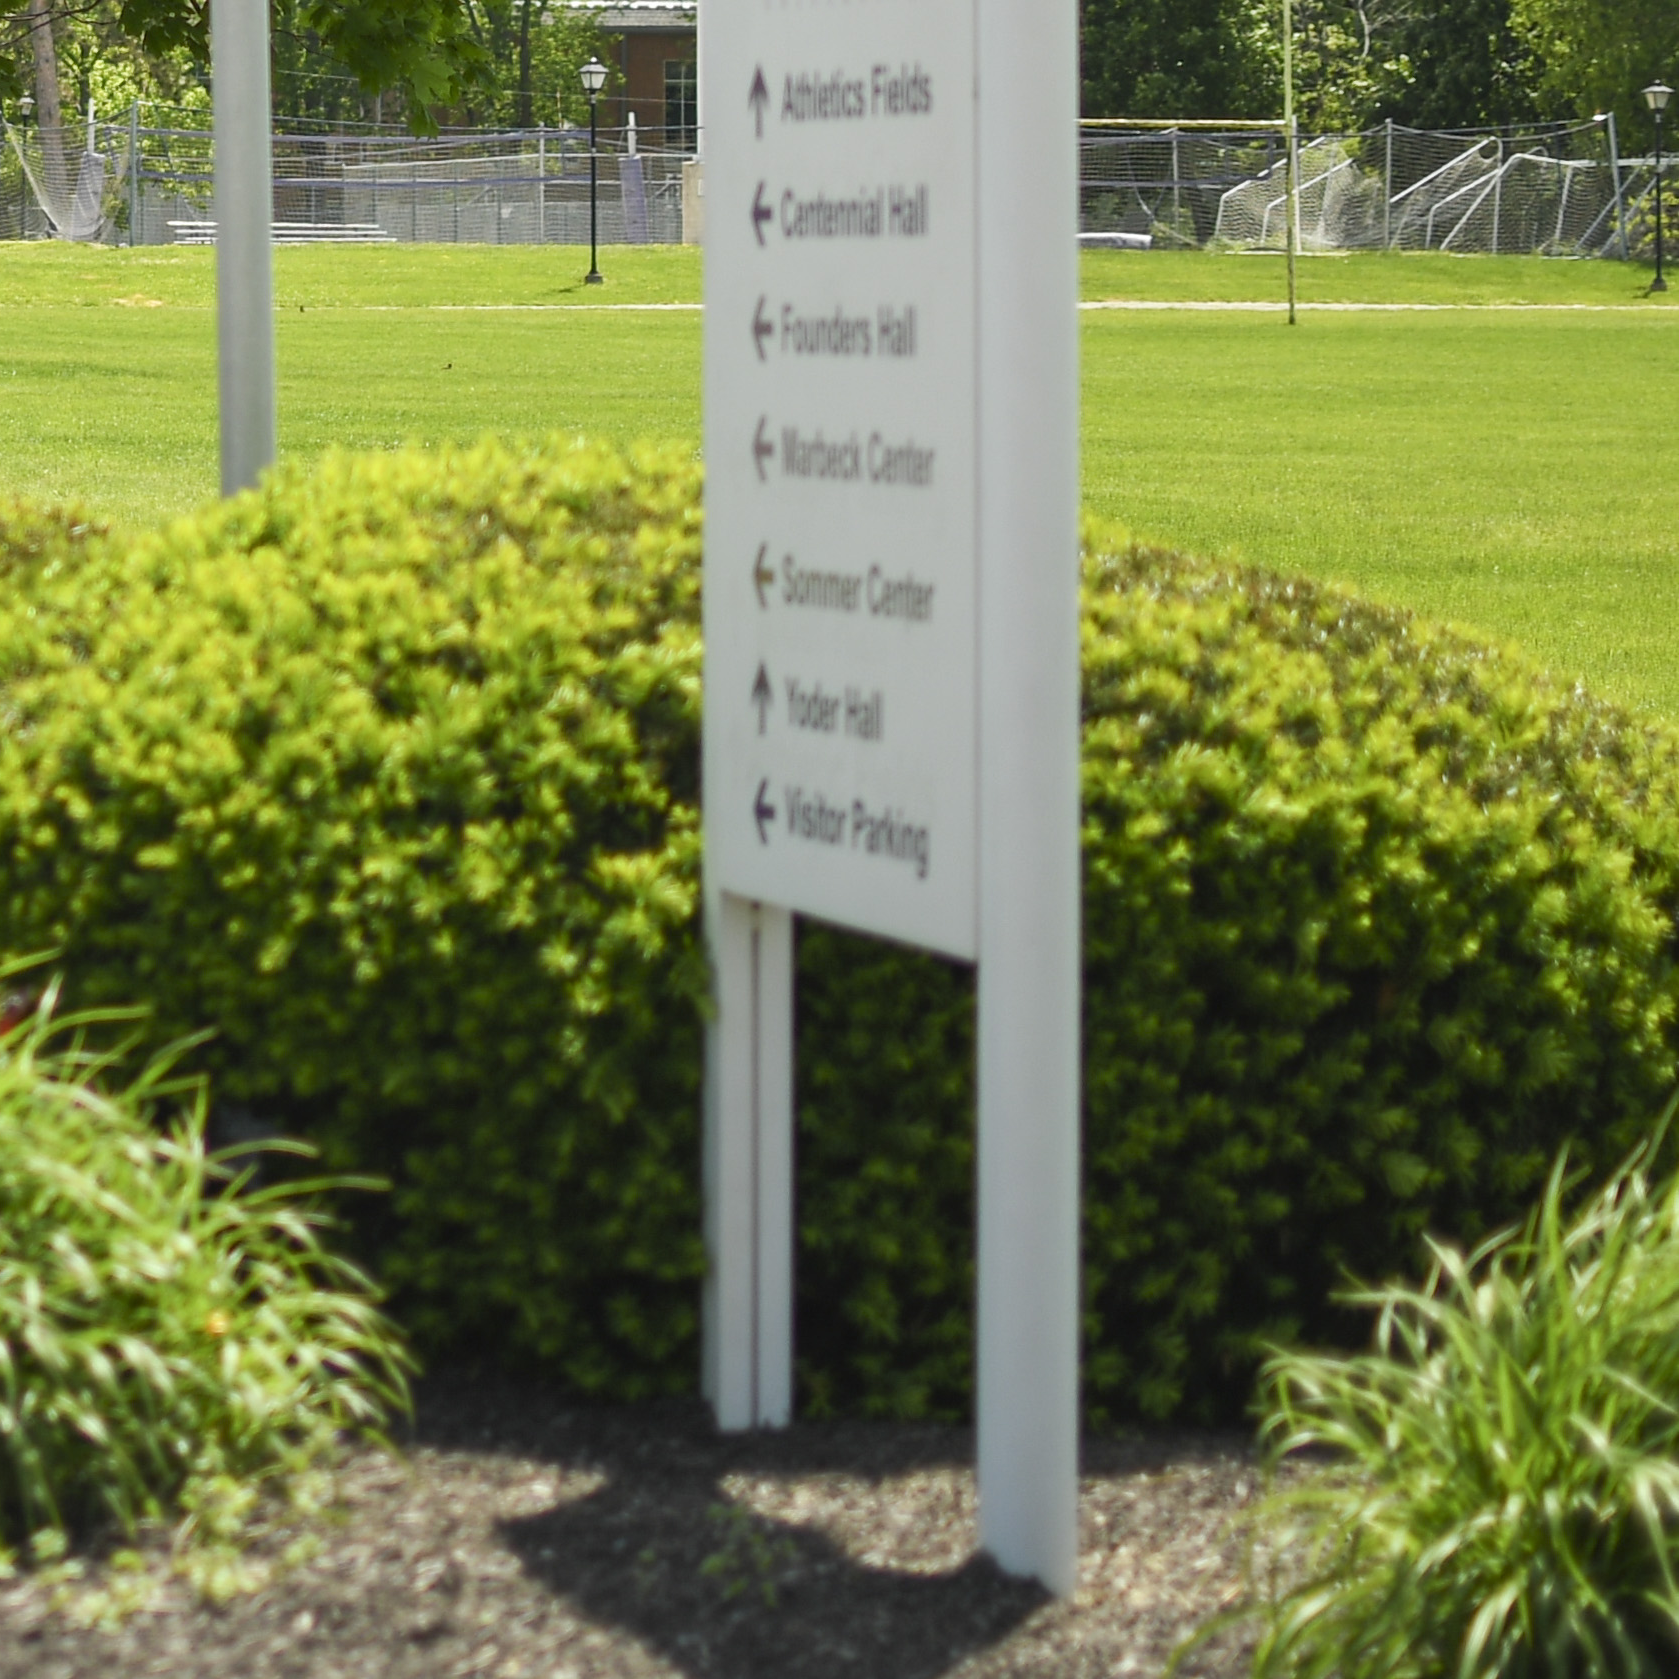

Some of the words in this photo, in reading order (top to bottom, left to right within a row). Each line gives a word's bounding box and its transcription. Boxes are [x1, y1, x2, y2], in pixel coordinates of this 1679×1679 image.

[781, 71, 865, 121] Athletics
[871, 61, 932, 116] Fields
[780, 187, 883, 239] Centennial
[888, 182, 930, 238] Hall
[780, 304, 871, 357] Founders
[876, 304, 918, 358] Hall
[867, 430, 936, 488] Center
[782, 555, 862, 612] Sommer
[867, 563, 935, 621] Center
[785, 676, 840, 732] Yoder
[845, 686, 886, 742] Hall
[786, 787, 845, 845] Visitor
[852, 799, 930, 880] Parking
